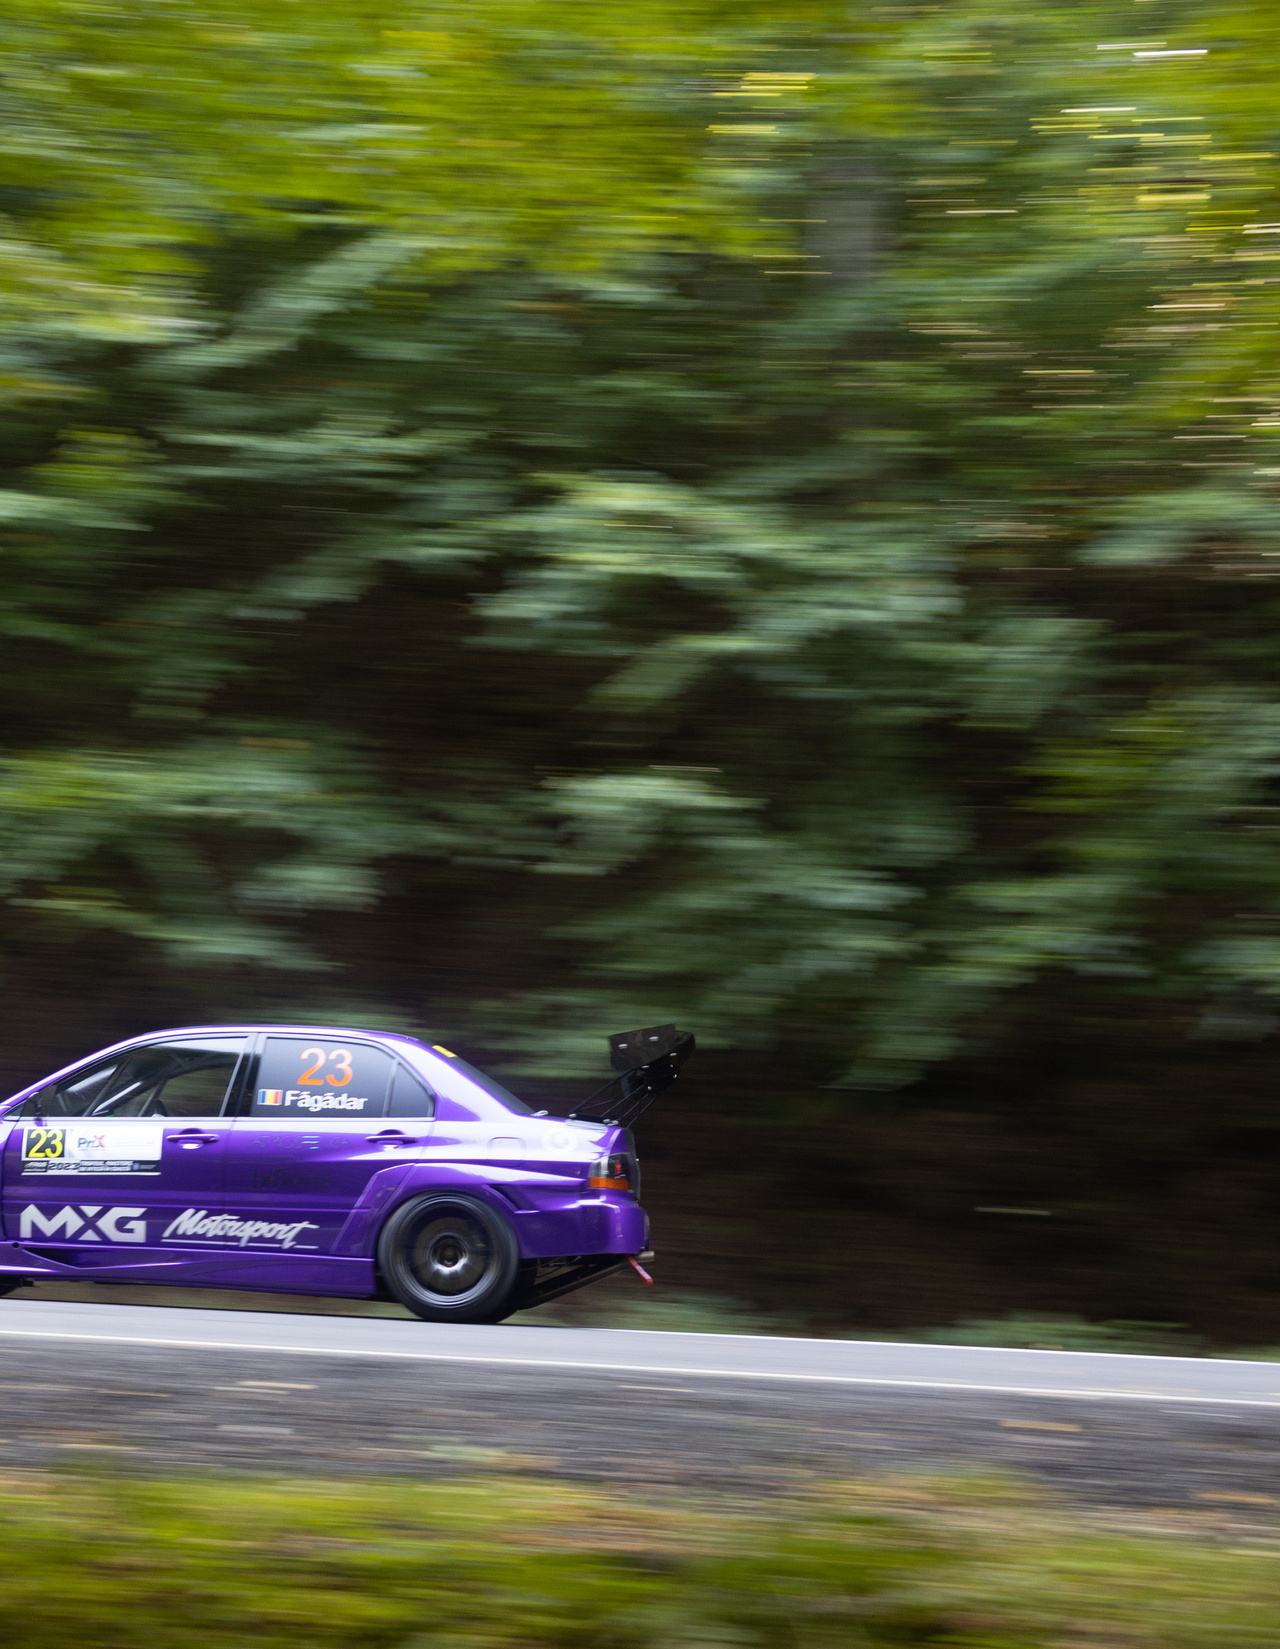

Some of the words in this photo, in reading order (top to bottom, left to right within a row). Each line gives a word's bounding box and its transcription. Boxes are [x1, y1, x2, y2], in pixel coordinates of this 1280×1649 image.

[297, 1048, 353, 1087] 23
[28, 1129, 63, 1158] 23
[20, 1204, 147, 1243] MXG
[162, 1208, 319, 1249] Motorsport
